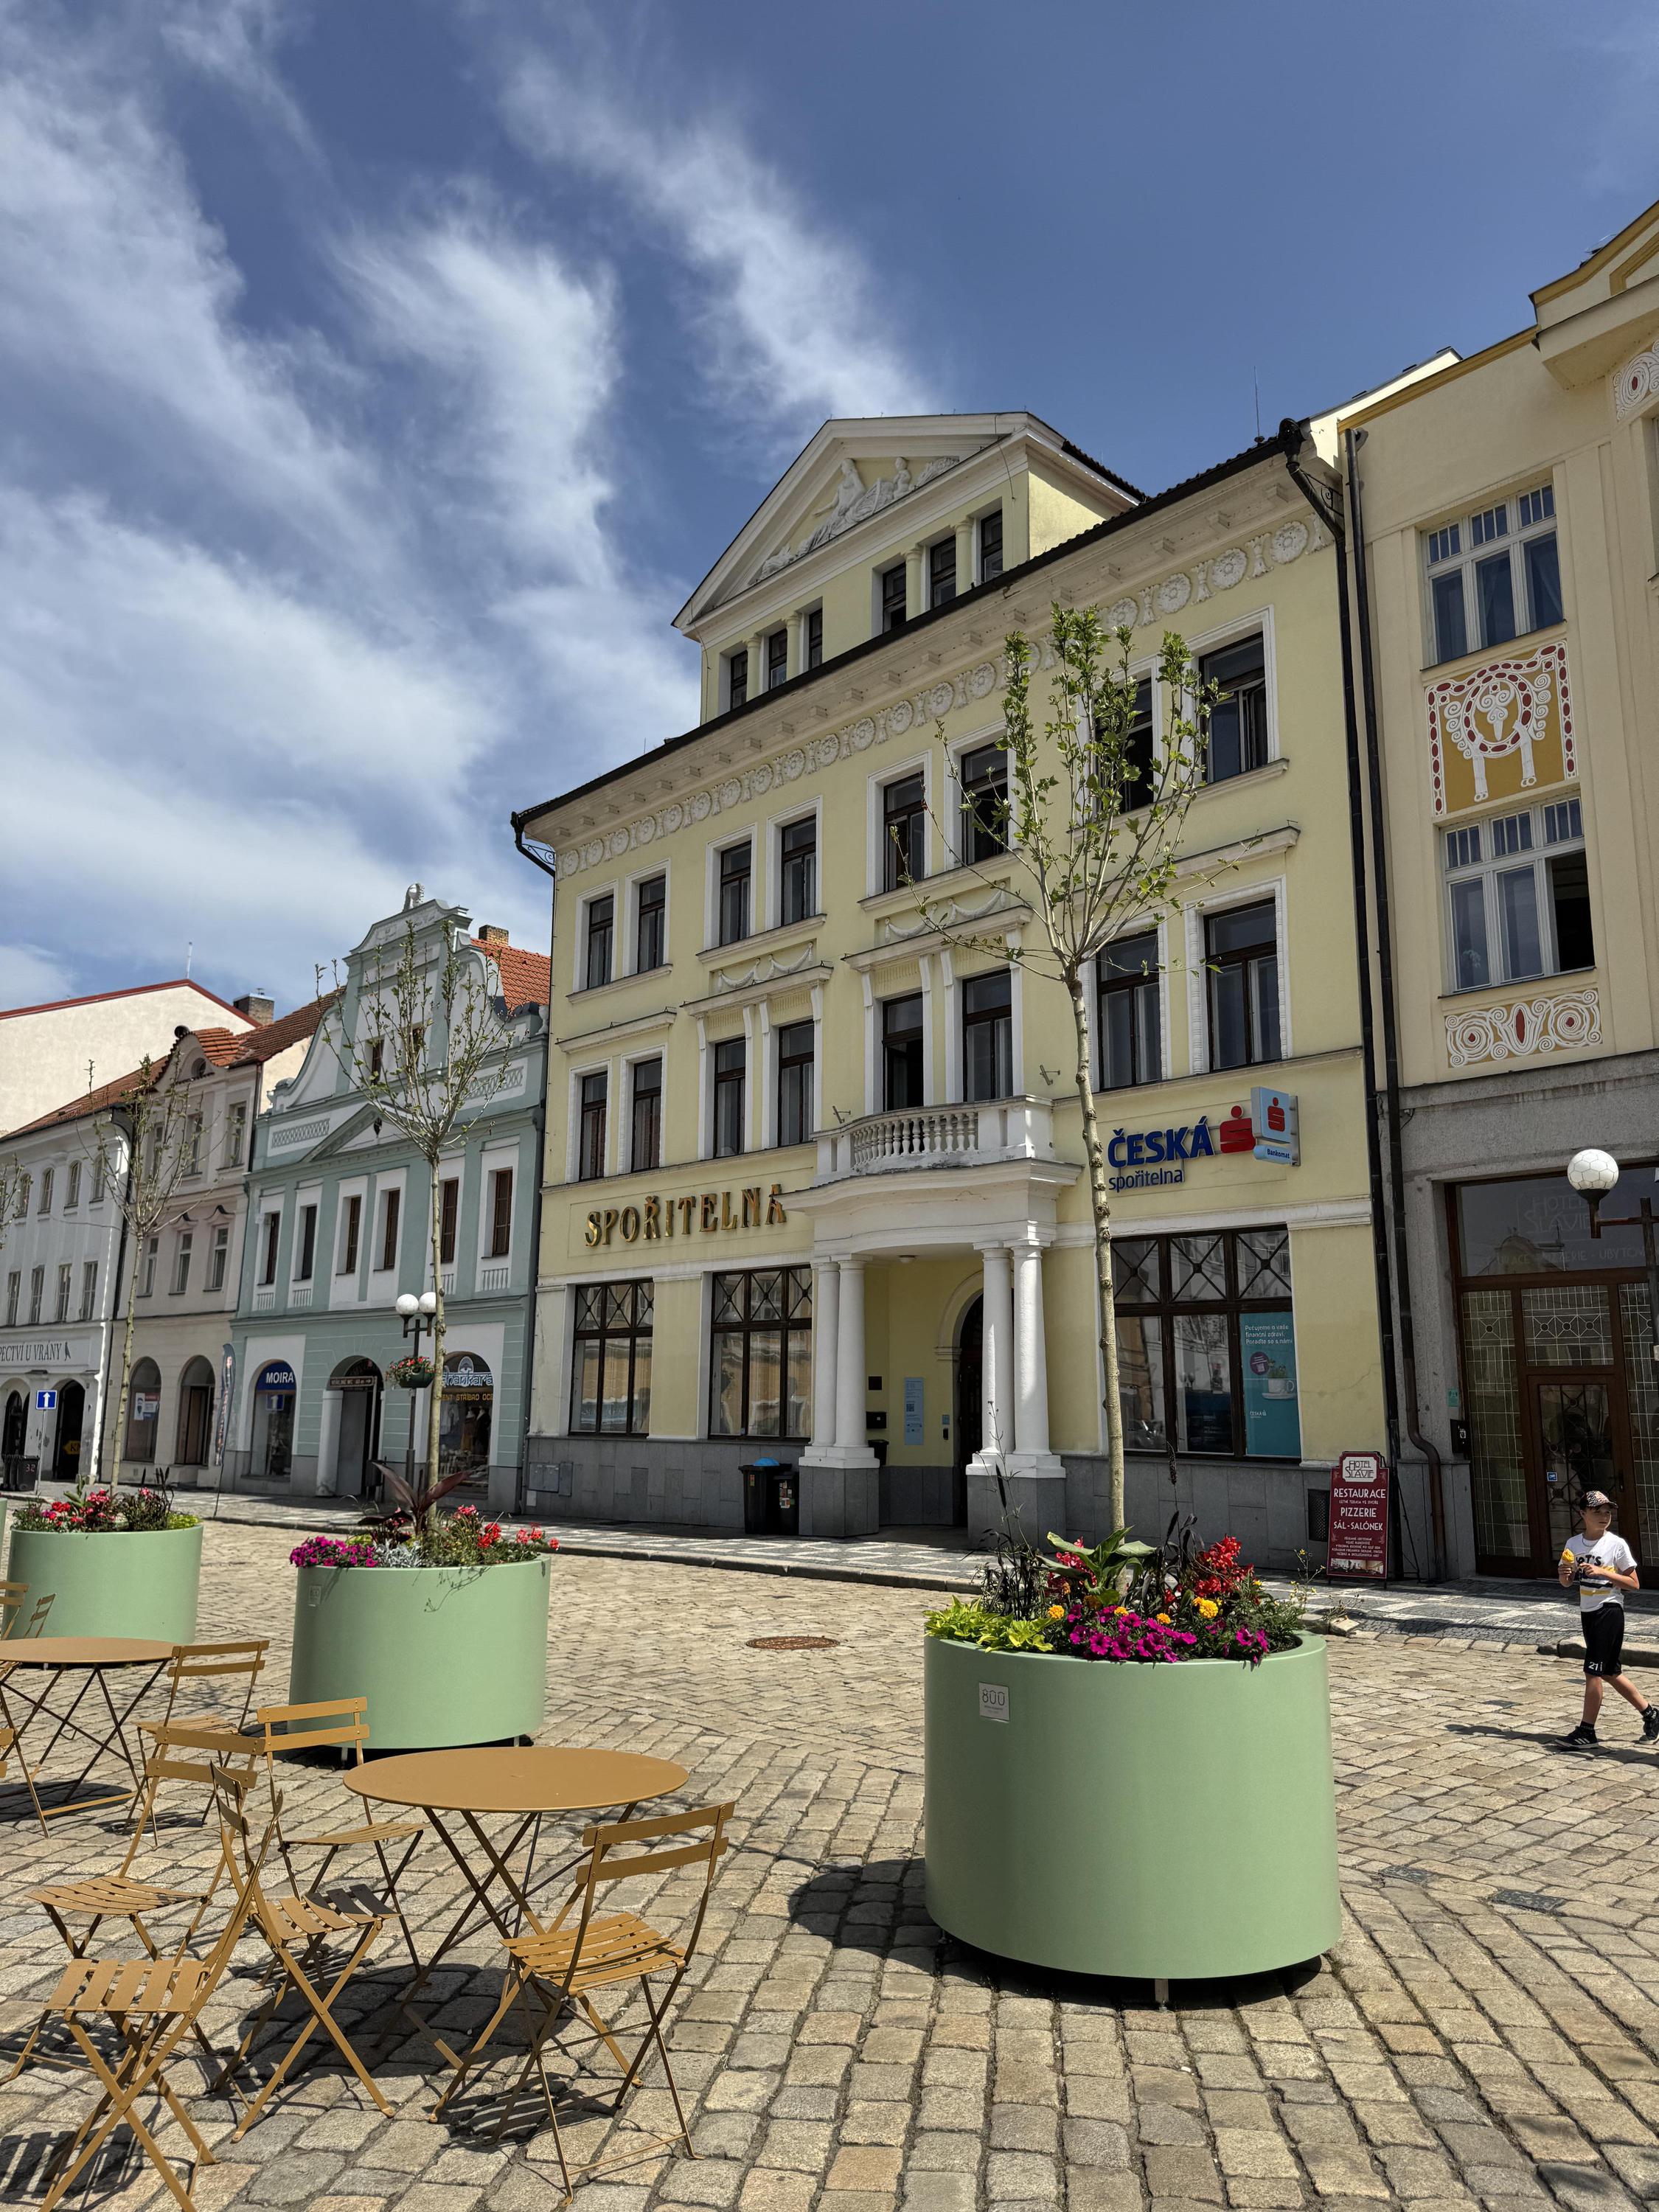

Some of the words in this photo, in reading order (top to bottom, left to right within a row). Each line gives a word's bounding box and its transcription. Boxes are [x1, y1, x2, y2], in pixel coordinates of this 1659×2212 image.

[1107, 1116, 1215, 1169] ČESKÁ
[1267, 1148, 1290, 1159] Bankomat
[1108, 1168, 1184, 1193] spořitelna
[585, 1183, 787, 1247] SPOŘITELNA
[26, 1344, 32, 1361] U
[34, 1339, 62, 1361] VRÁNY
[265, 1372, 293, 1384] MOIRA
[1349, 1461, 1371, 1471] HOTEL
[1333, 1488, 1386, 1498] RESTAURACE
[1340, 1507, 1377, 1517] PIZZERIE
[1333, 1520, 1346, 1529] SÁL
[1351, 1520, 1383, 1531] SALÓNEK
[1587, 1661, 1599, 1672] 21
[982, 1688, 1005, 1705] 800
